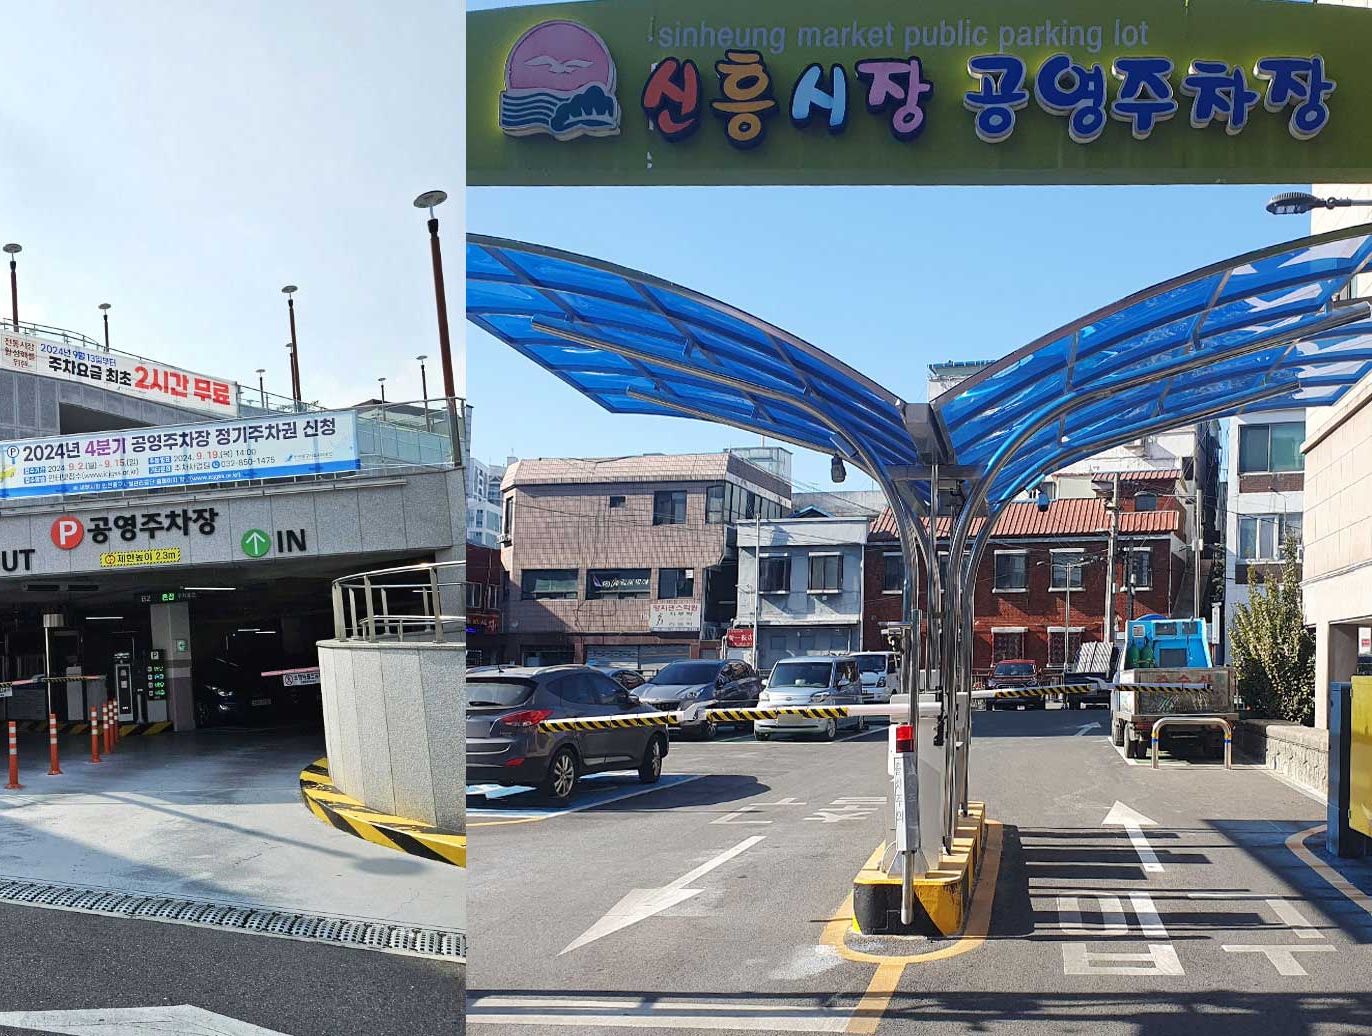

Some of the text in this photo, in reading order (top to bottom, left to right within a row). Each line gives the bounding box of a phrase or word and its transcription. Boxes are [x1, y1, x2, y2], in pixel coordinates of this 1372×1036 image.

[658, 18, 1149, 54] sinheung market public parking lot
[641, 49, 1336, 150] 신흥시장 공영주차장
[40, 343, 71, 358] 2024년
[86, 354, 117, 367] 13일부터
[48, 355, 232, 406] 주차요금 최초 2시간 무료
[23, 416, 337, 463] 2024년 4분기 공영주차장 정기주차권 신청
[87, 507, 219, 544] 공영주차장
[277, 529, 307, 553] IN
[155, 551, 176, 561] 2.3m
[1058, 891, 1338, 976] 입구
